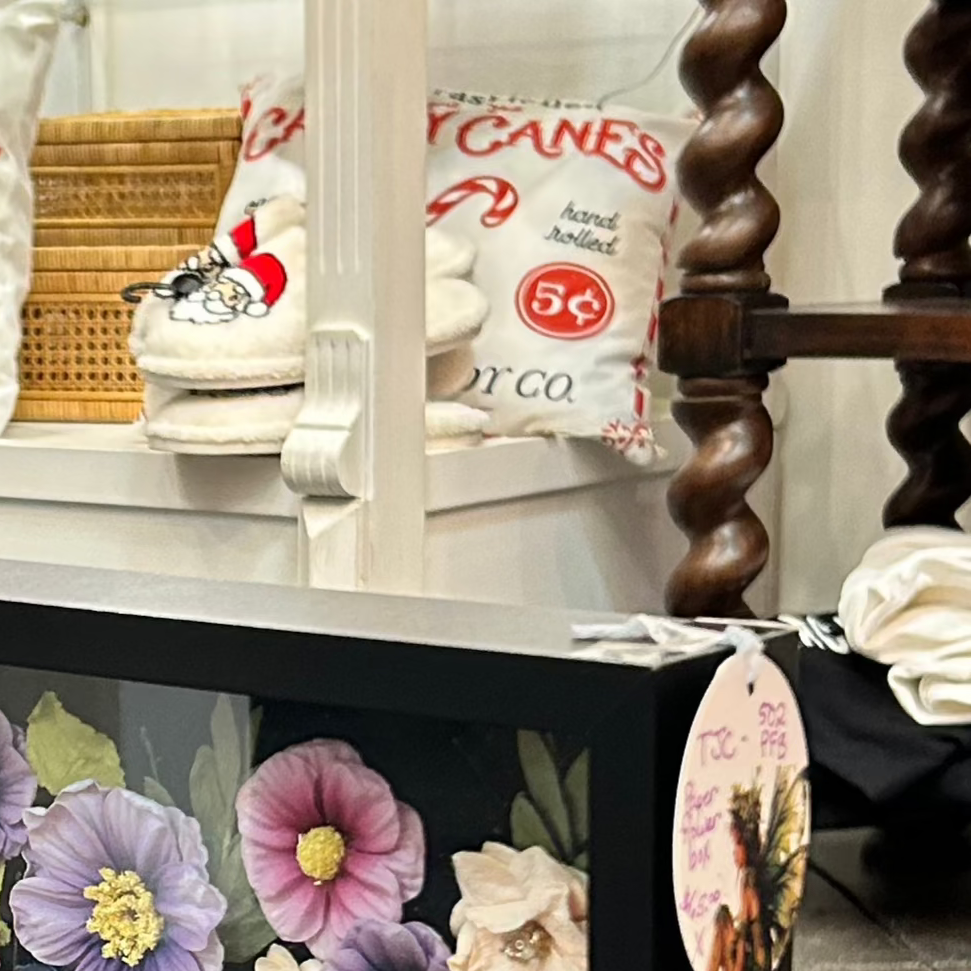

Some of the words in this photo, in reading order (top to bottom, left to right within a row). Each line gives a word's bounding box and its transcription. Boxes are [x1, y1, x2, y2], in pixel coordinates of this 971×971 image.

[456, 113, 667, 194] CANES
[559, 200, 621, 230] hand
[544, 225, 620, 257] rolled
[530, 280, 602, 327] 5¢
